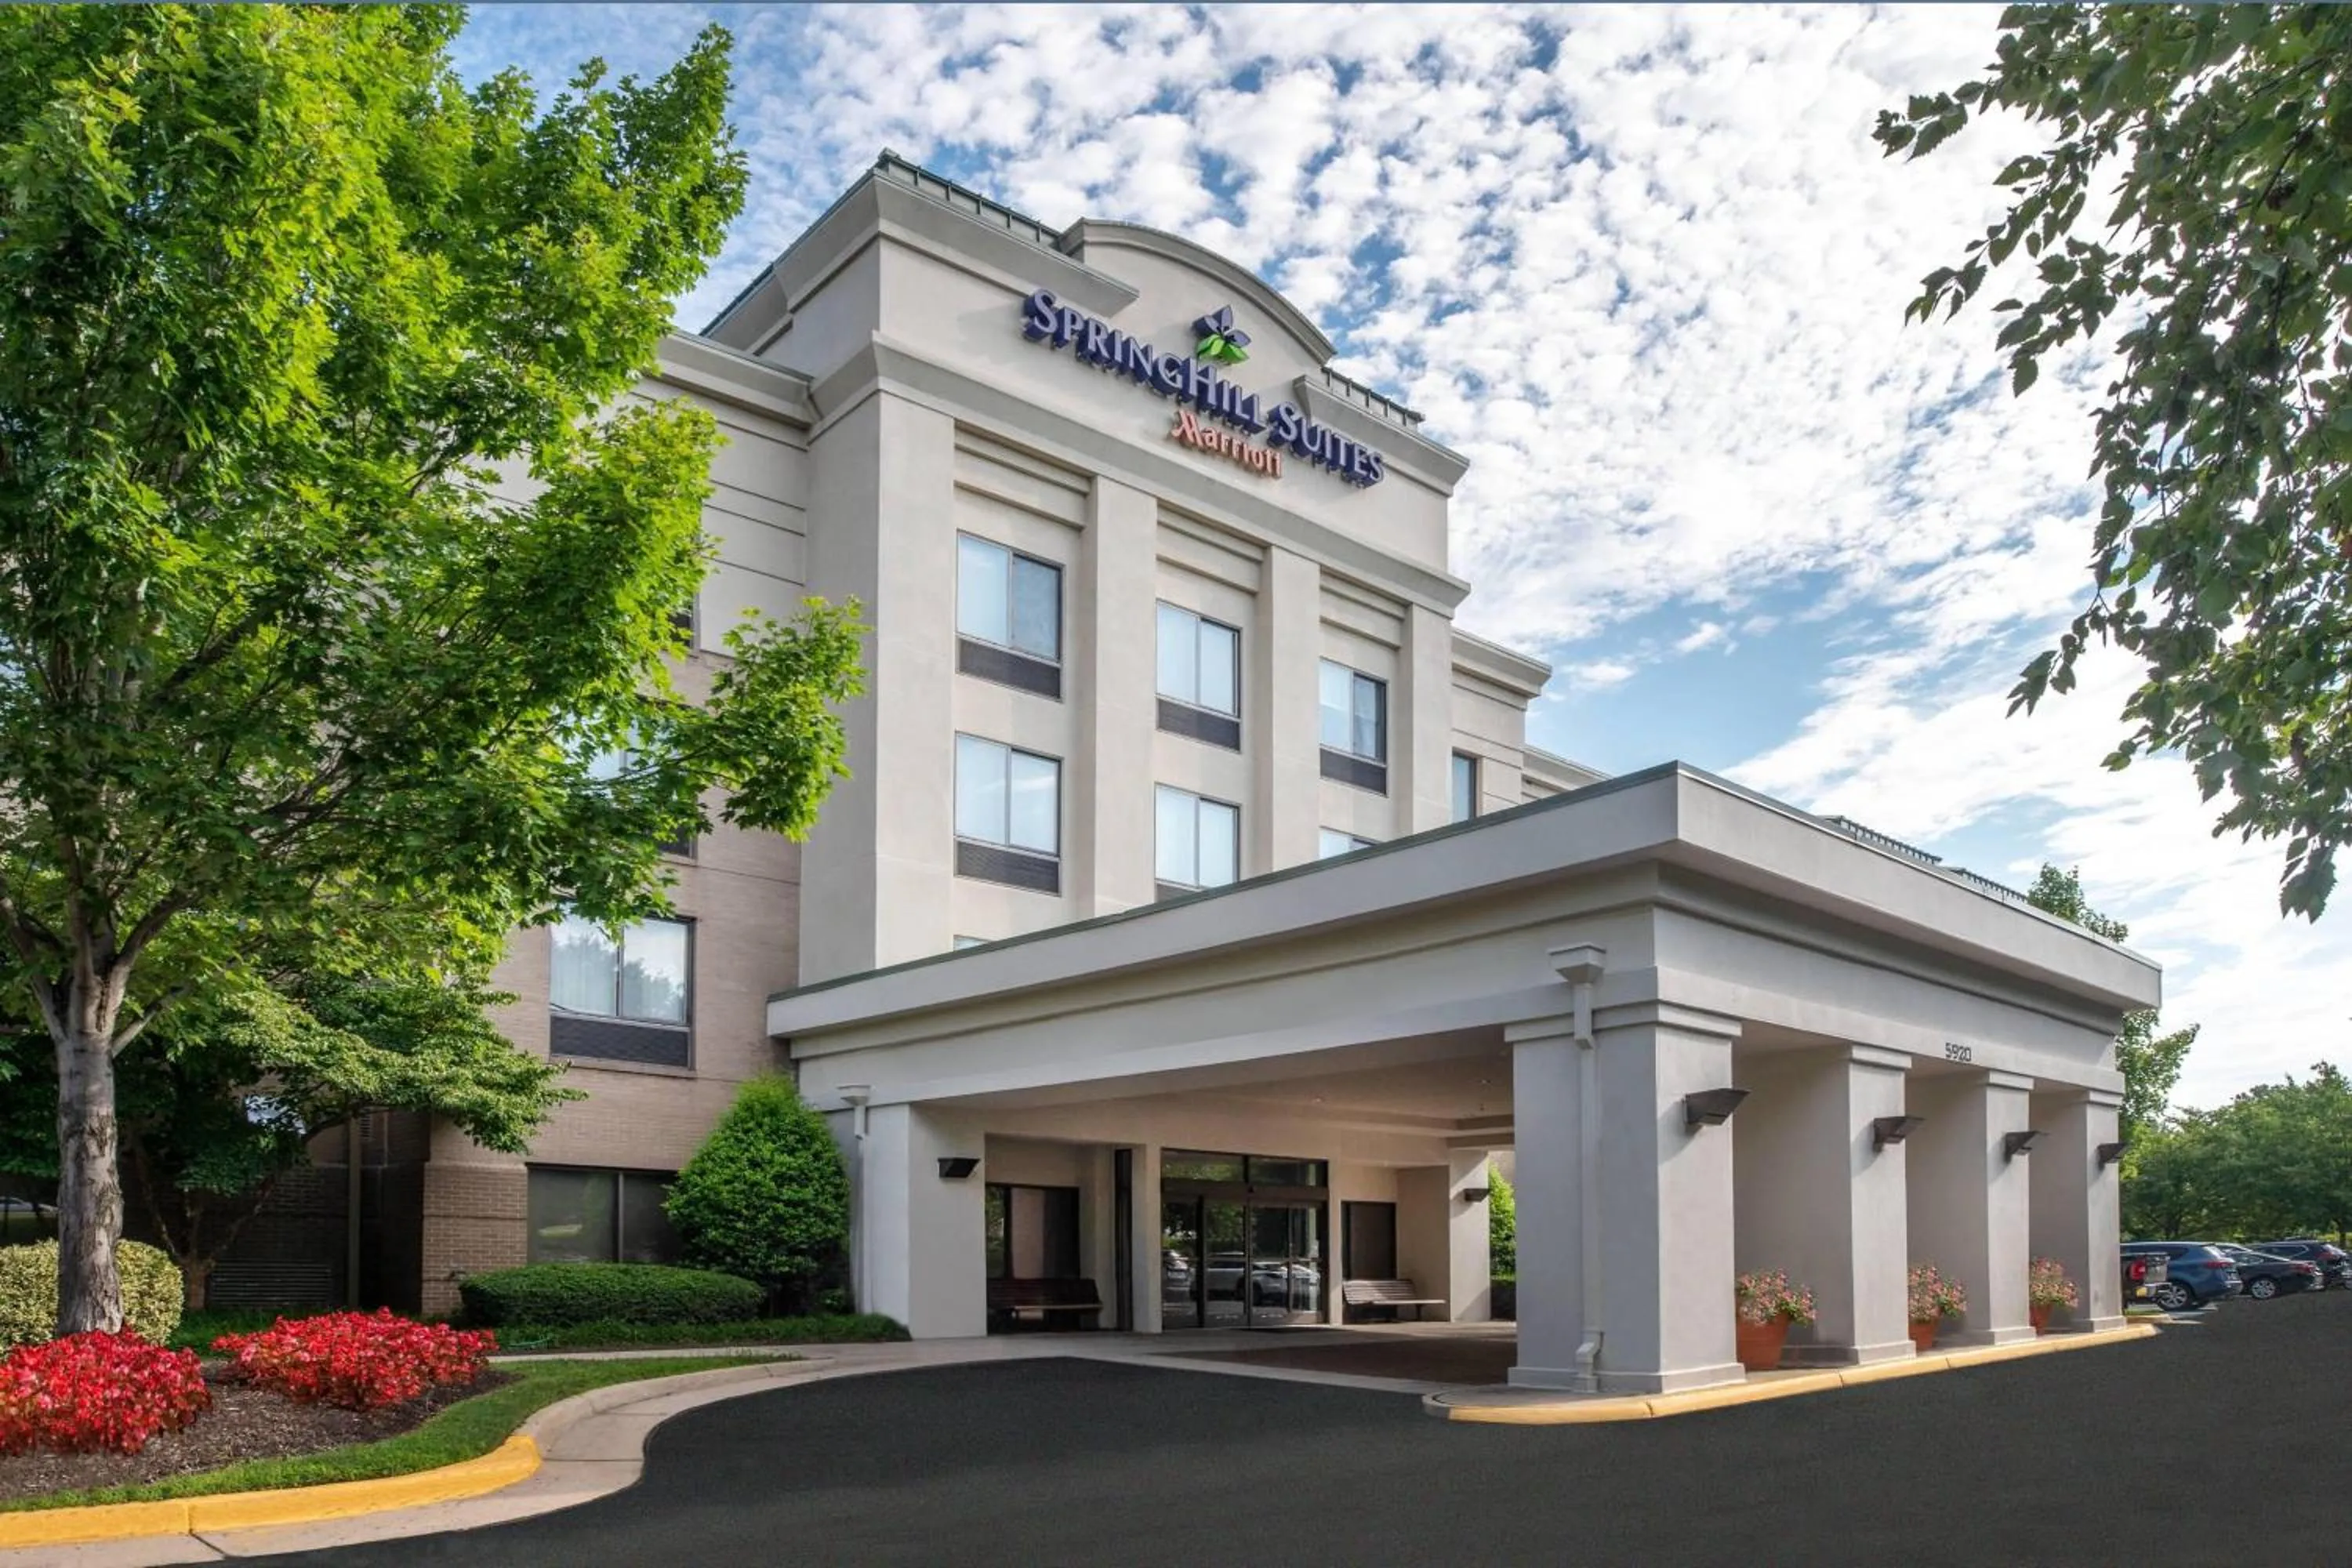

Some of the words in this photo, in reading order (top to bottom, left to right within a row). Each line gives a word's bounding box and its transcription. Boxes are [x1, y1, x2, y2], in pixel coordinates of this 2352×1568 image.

[1025, 288, 1268, 432] SPRINGHILL
[1269, 401, 1385, 486] SUITES
[1171, 409, 1283, 479] Marriott
[1945, 1042, 1972, 1062] 5920
